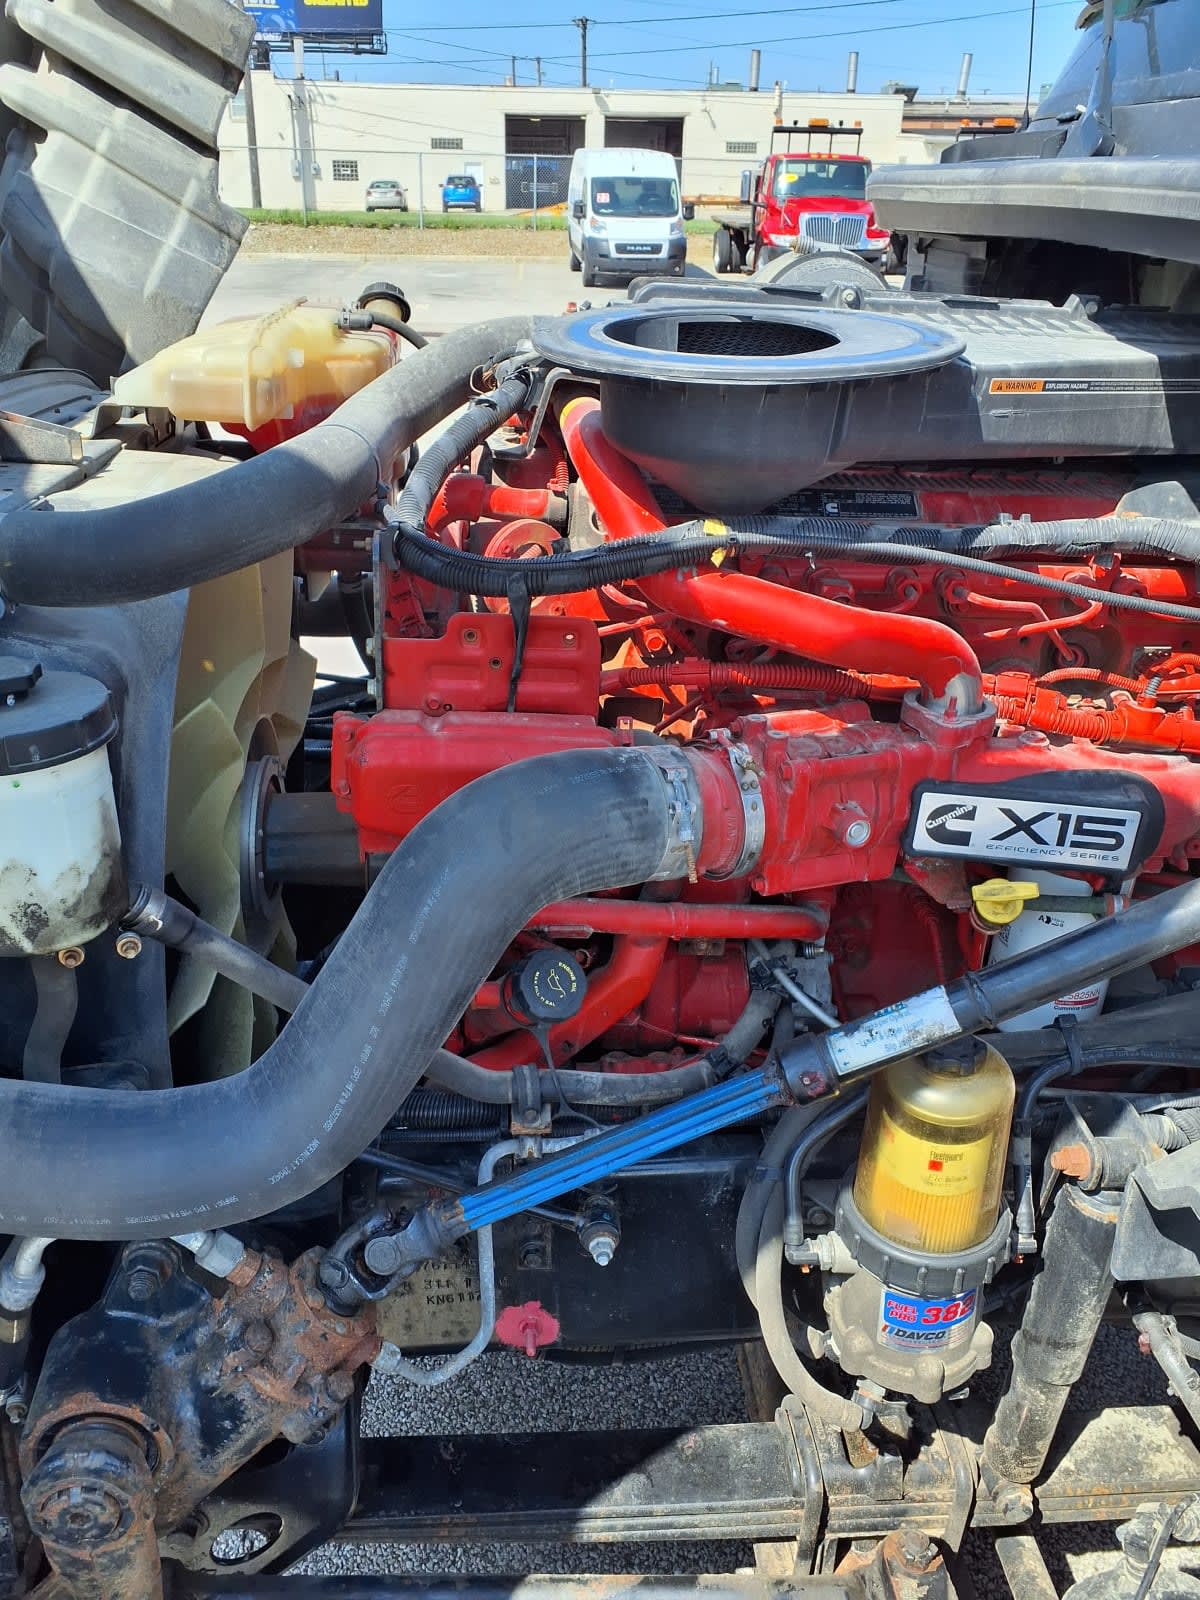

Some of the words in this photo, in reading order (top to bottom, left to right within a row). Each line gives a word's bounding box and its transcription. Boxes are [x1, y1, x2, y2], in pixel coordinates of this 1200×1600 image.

[1005, 382, 1037, 390] WARNING
[925, 803, 975, 830] Cummins
[988, 807, 1128, 852] X15
[985, 844, 1066, 856] EFFICIENCY
[1069, 851, 1120, 862] SERIES
[887, 1299, 918, 1316] FUEL
[889, 1309, 917, 1323] PRO
[894, 1328, 946, 1340] DAVCO
